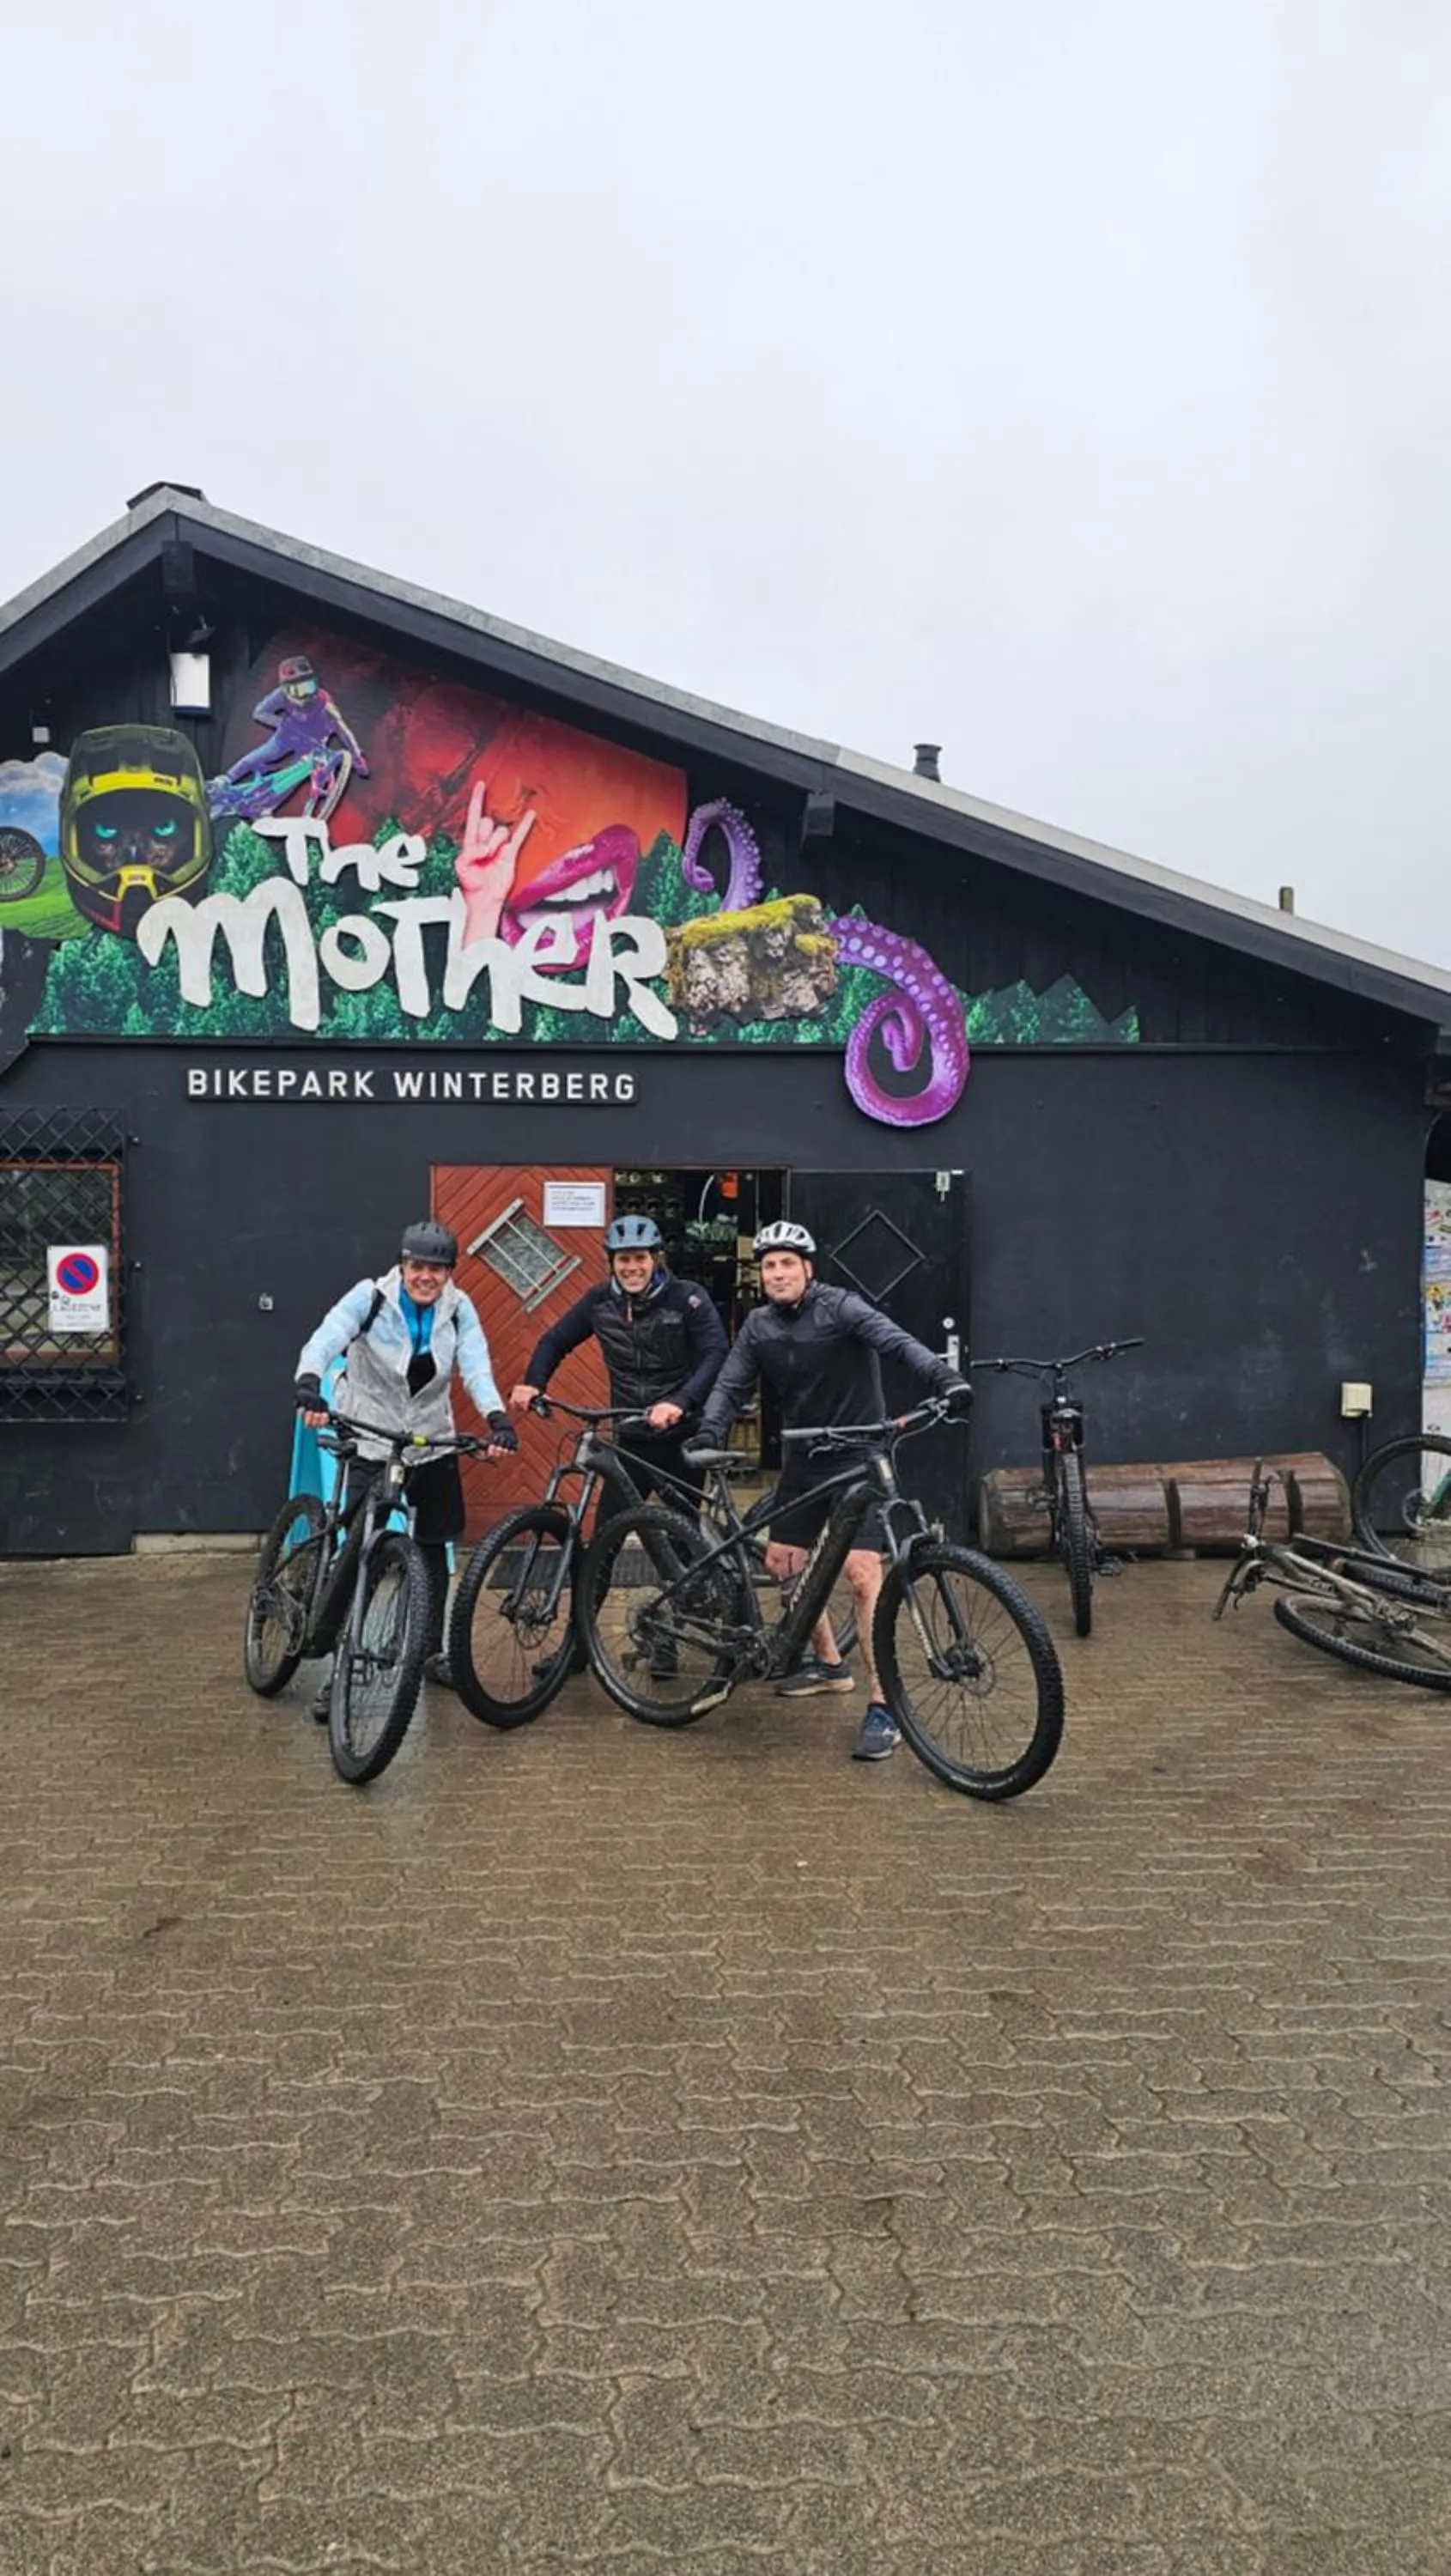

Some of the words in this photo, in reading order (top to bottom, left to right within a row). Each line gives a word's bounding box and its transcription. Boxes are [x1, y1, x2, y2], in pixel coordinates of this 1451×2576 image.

[252, 817, 426, 891] The
[187, 1069, 375, 1097] BIKEPARK
[393, 1071, 635, 1100] WINTERBERG
